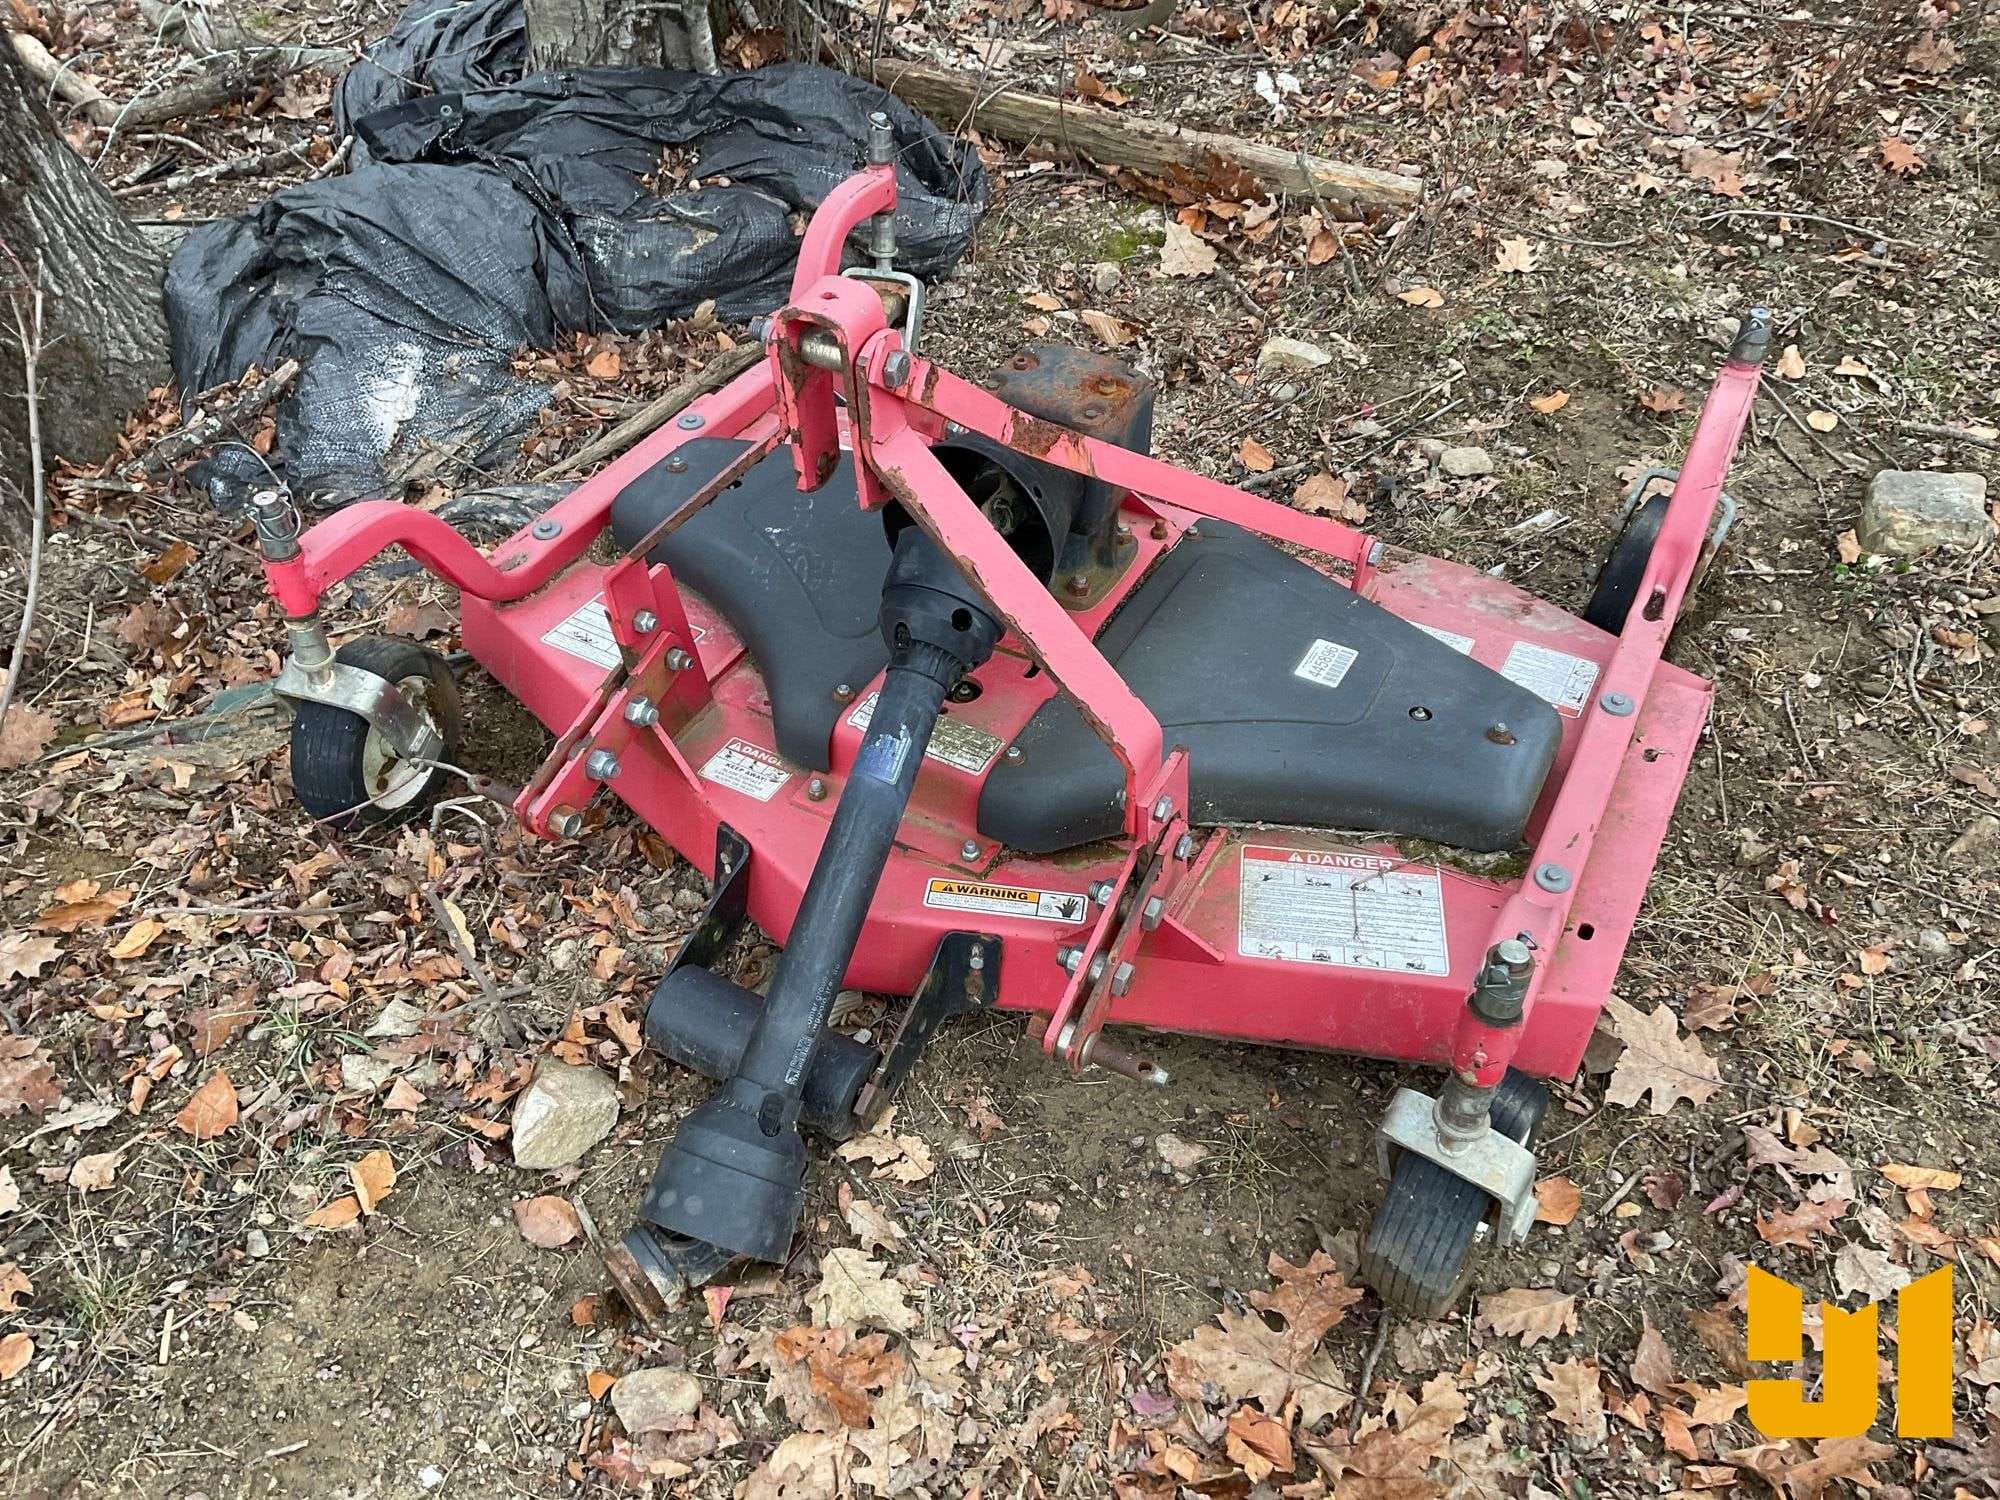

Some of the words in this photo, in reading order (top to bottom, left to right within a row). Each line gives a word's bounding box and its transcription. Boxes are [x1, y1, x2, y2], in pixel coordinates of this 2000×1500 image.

[742, 745, 785, 768] DANGE
[1307, 854, 1393, 871] DANGER
[956, 884, 1029, 901] WARNING
